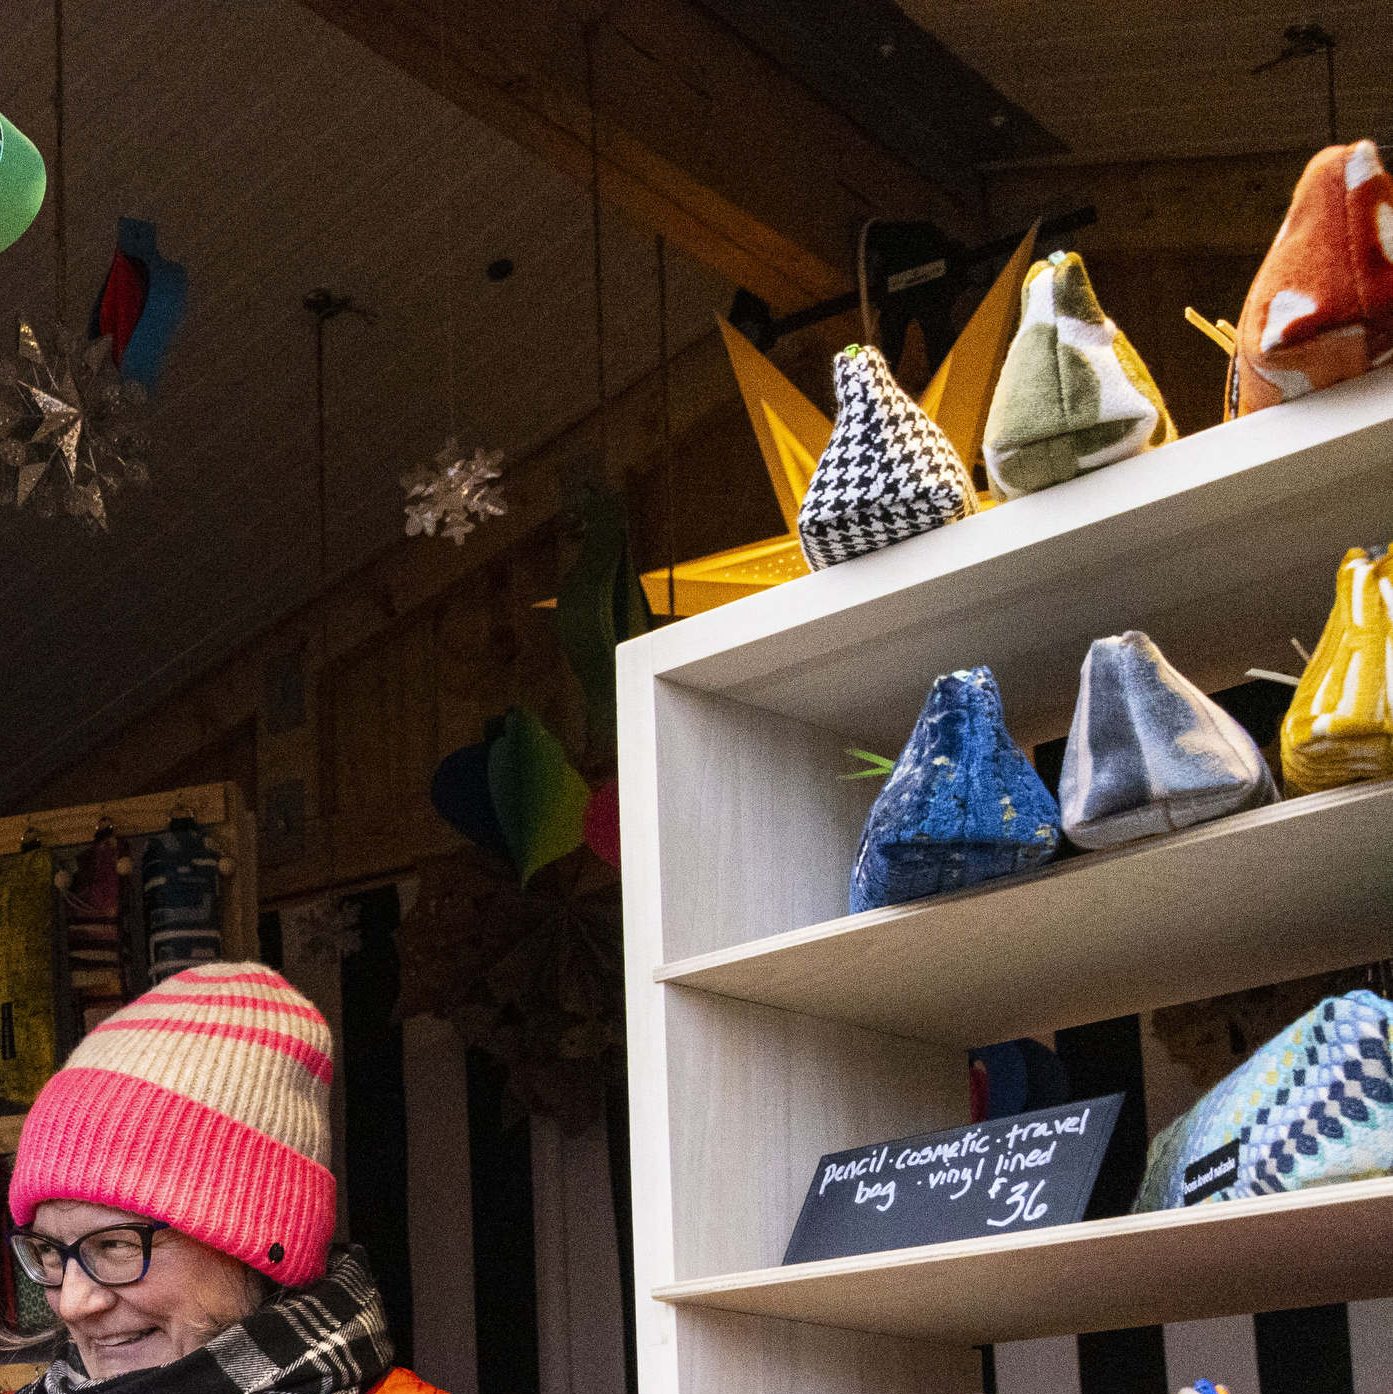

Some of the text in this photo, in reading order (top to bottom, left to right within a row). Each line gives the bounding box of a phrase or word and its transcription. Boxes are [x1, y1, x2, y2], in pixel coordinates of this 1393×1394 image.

[855, 1180, 896, 1212] bag
[995, 1141, 1057, 1175] lined
[986, 1177, 1049, 1228] $36
